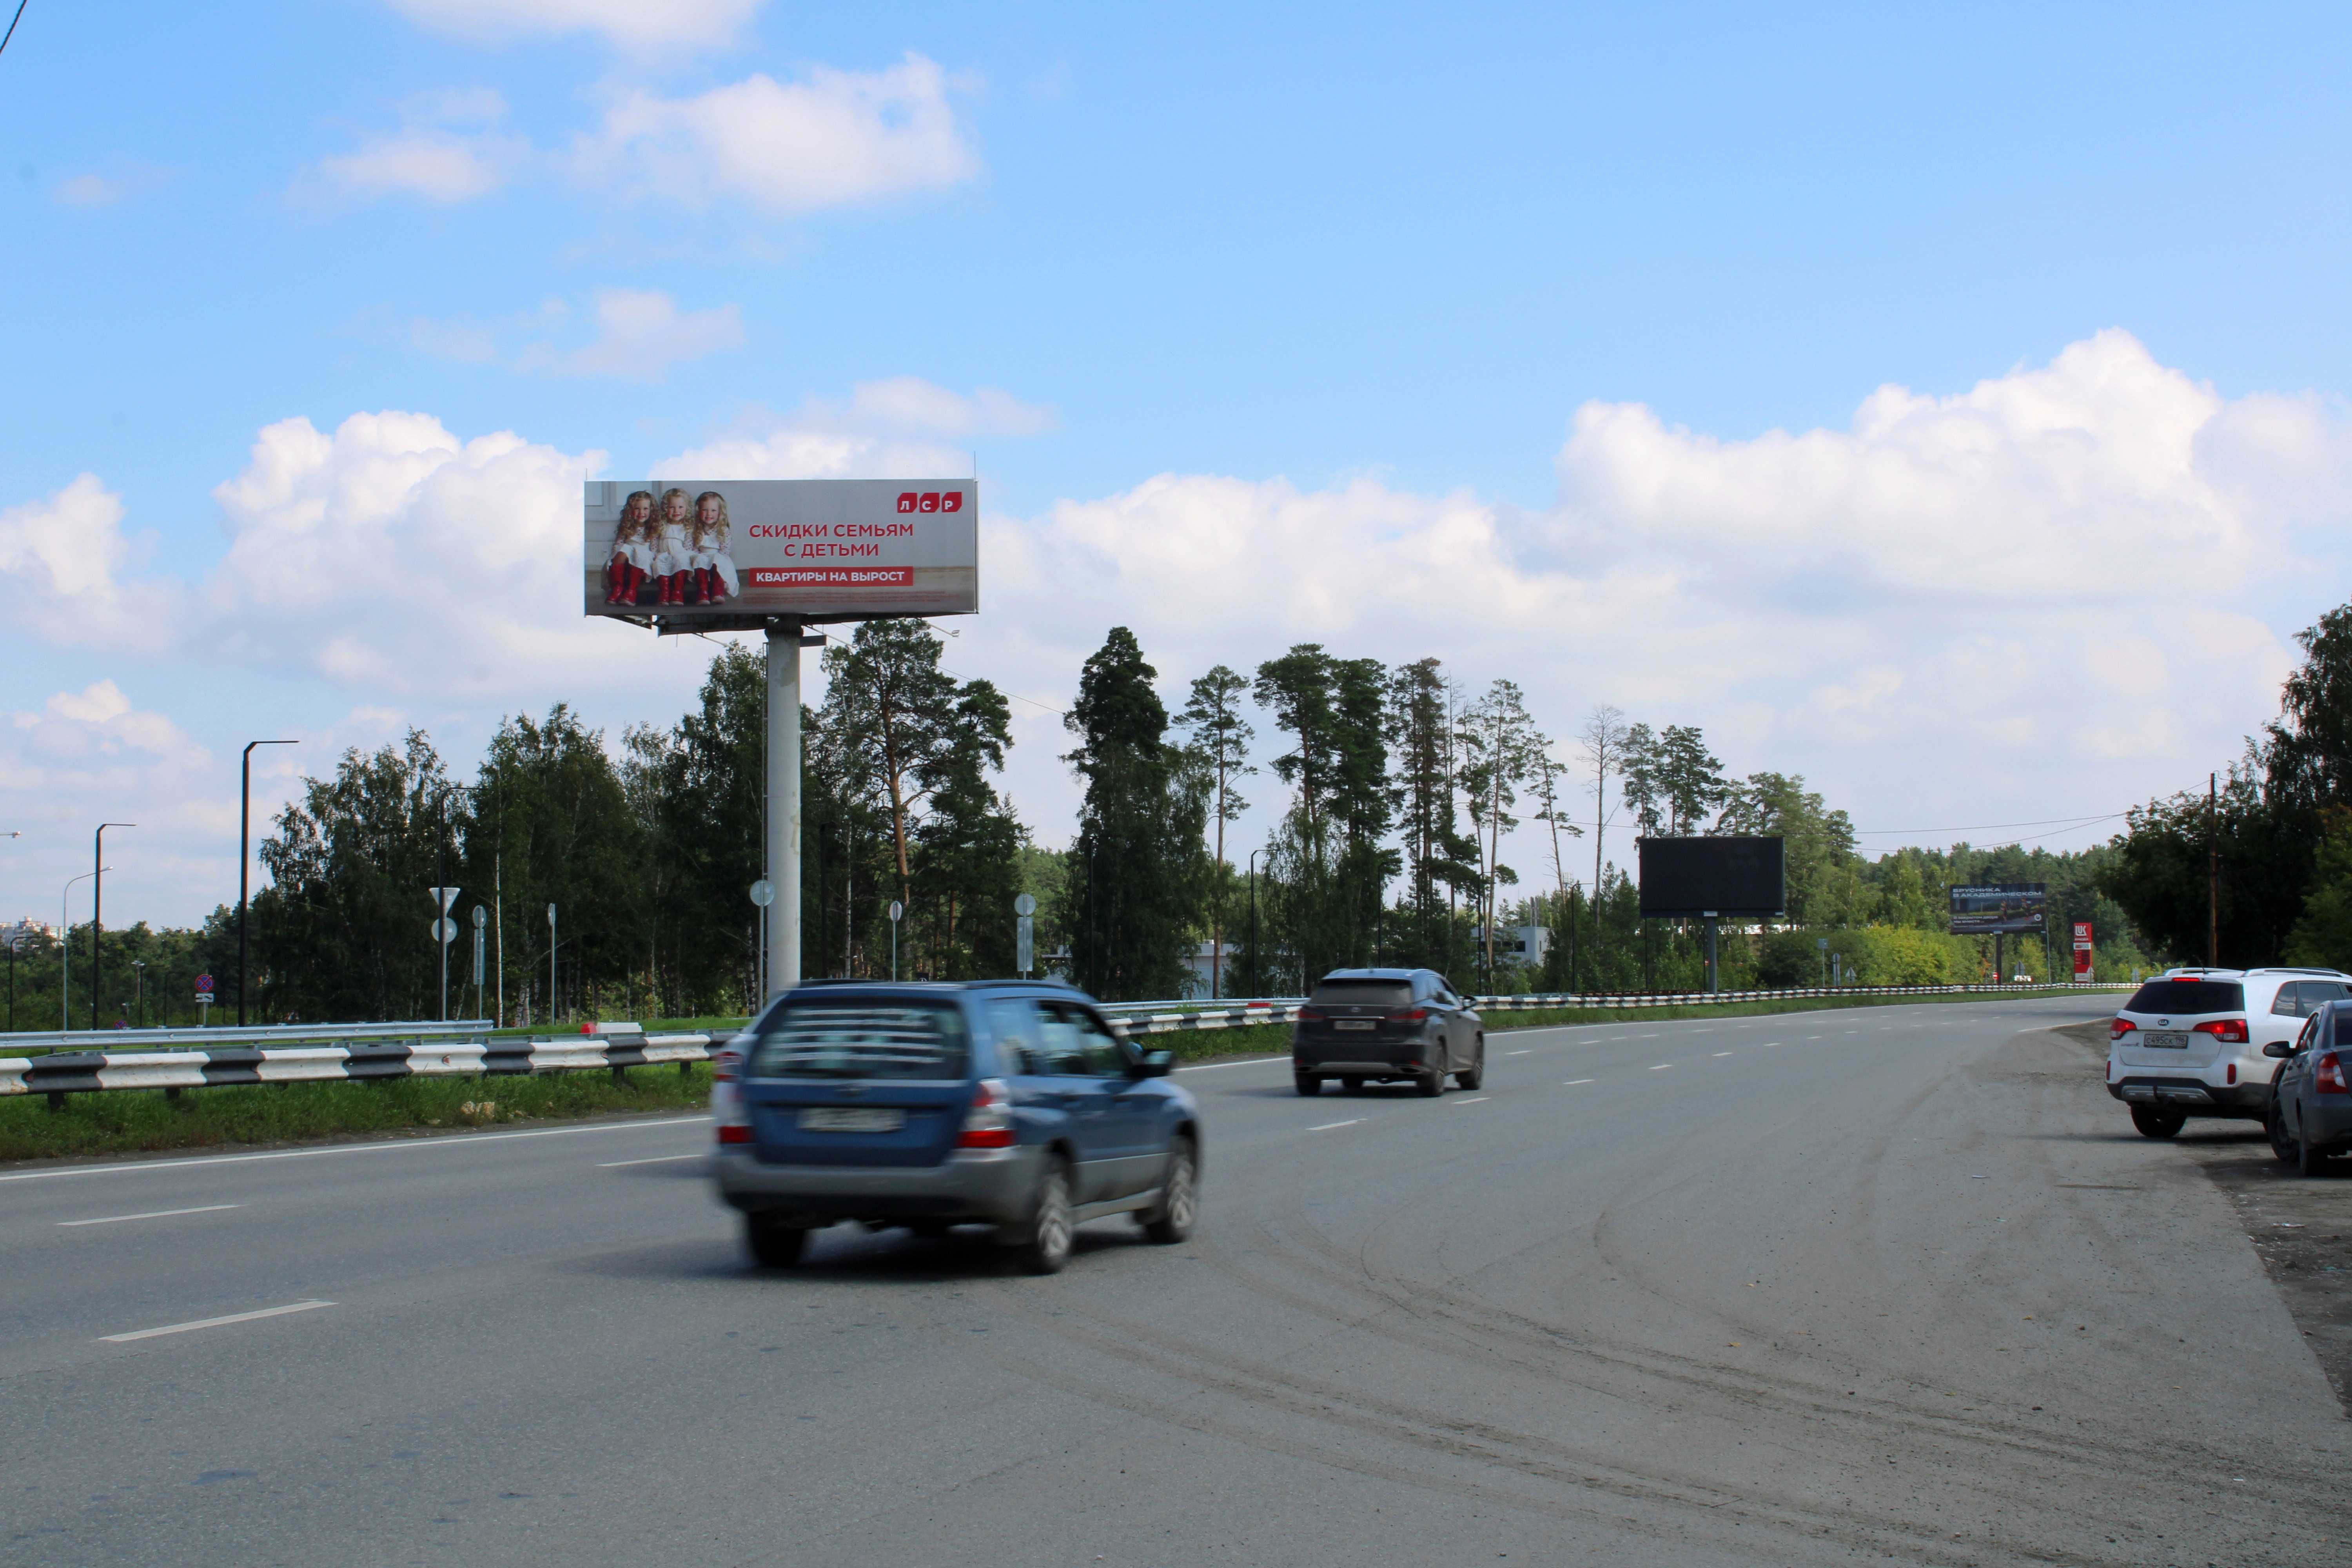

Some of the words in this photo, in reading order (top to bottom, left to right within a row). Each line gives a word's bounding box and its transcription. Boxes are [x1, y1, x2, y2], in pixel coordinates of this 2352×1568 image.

[900, 501, 953, 510] ЛСР
[749, 524, 827, 539] СКИДКИ
[833, 523, 913, 537] СЕМЬЯМ
[784, 544, 796, 557] С
[801, 543, 878, 559] ДЕТЬМИ
[756, 572, 826, 582] КВАРТИРЫ
[830, 572, 848, 581] НА
[851, 572, 904, 581] ВЫРОСТ
